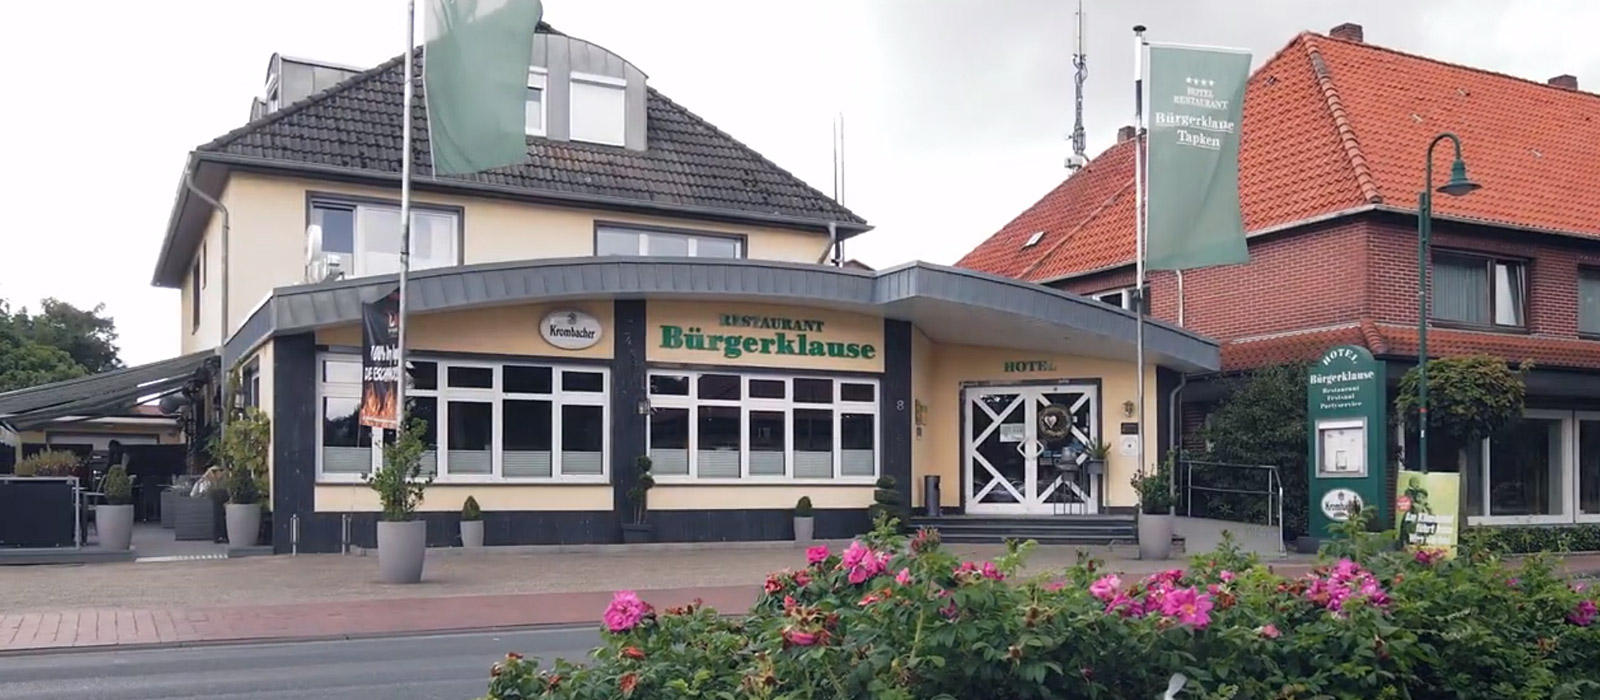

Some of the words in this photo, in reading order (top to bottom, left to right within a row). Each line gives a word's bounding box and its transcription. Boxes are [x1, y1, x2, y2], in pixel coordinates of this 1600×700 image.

[1187, 86, 1214, 98] HOTEL
[1173, 95, 1229, 110] RESTAURANT
[1176, 129, 1220, 147] Tapken
[719, 313, 824, 332] RESTAURANT
[549, 324, 596, 339] Krombacher
[659, 325, 876, 359] Bürgerklause
[1322, 348, 1358, 366] HOTEL
[1004, 360, 1057, 372] HOTEL
[1310, 370, 1375, 384] Bürgerklause
[1322, 385, 1360, 394] Restaurant
[896, 399, 905, 411] 8
[1320, 401, 1362, 410] Partyservice
